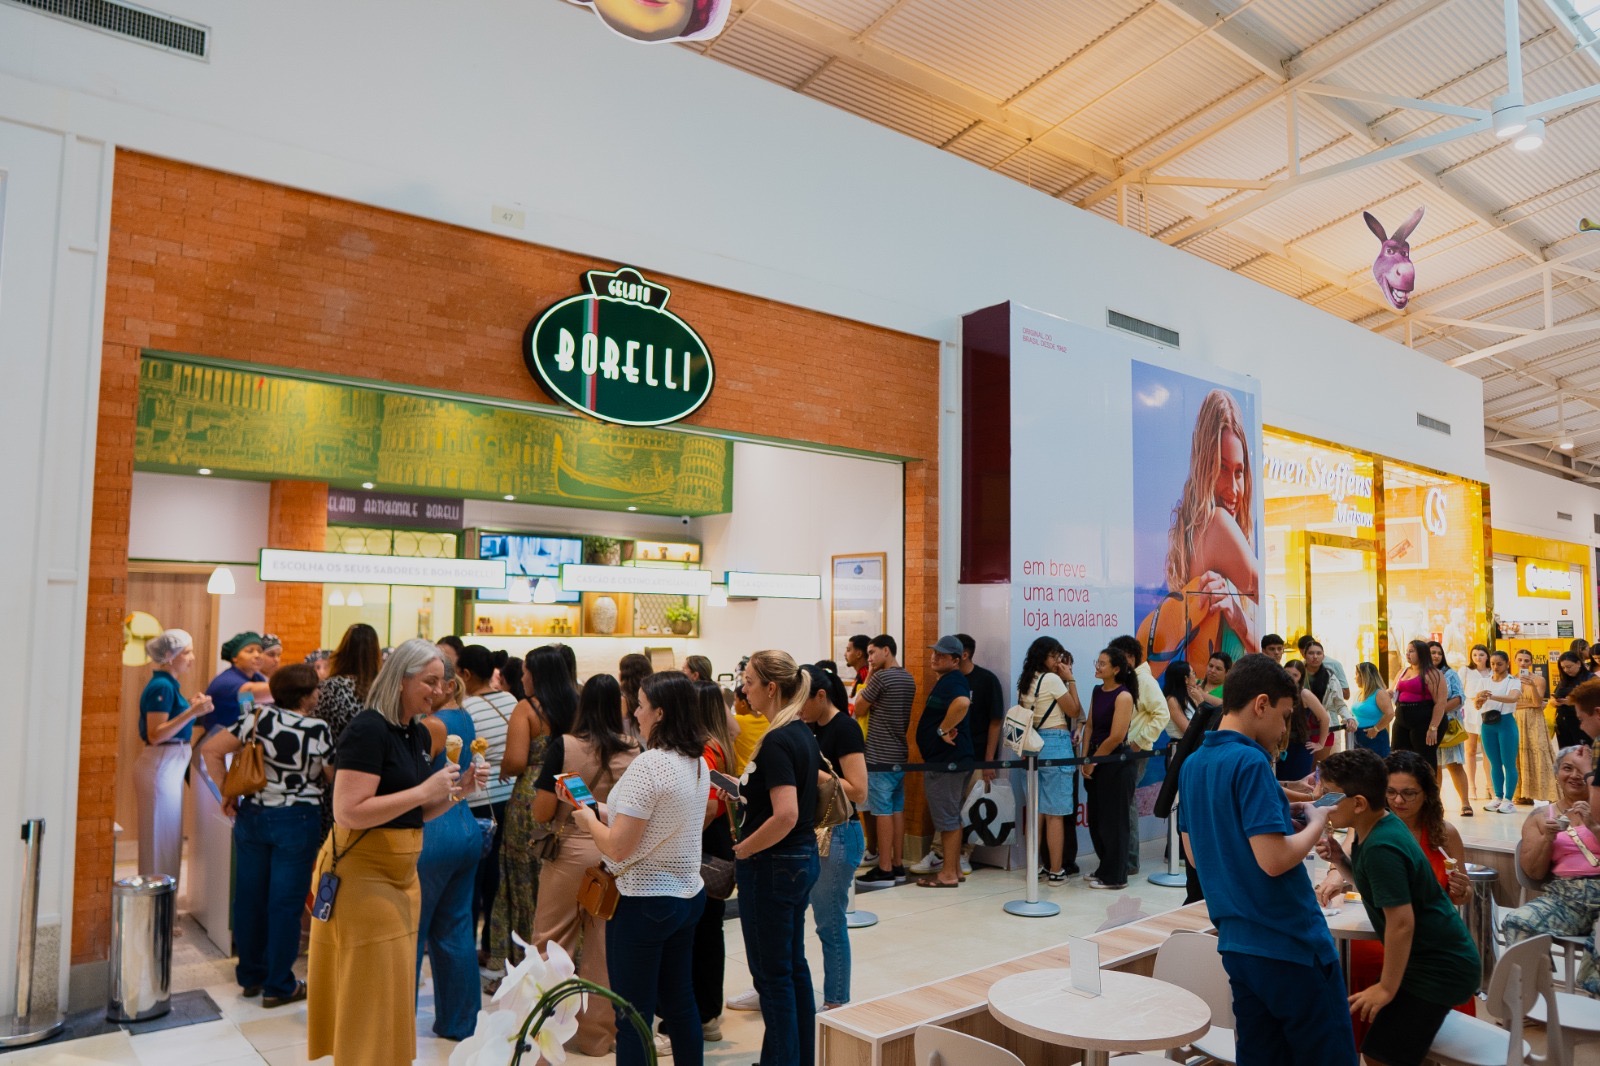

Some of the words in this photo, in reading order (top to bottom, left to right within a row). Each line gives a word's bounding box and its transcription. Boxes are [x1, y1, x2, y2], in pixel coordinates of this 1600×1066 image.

[502, 212, 513, 222] 47
[607, 279, 651, 304] GELATO
[1022, 327, 1044, 340] ORIGINAL
[1022, 335, 1040, 346] BRASIL
[1041, 340, 1056, 350] DESDE
[553, 327, 691, 392] BORELLI
[1308, 455, 1374, 502] Steffens
[426, 503, 460, 521] BORELLI
[1335, 503, 1374, 528] Maison
[273, 560, 324, 572] ESCOLHA
[326, 562, 341, 573] OS
[343, 563, 371, 574] SEUS
[373, 565, 421, 576] SABORES
[431, 568, 452, 577] BOM
[1023, 560, 1045, 576] em
[1049, 558, 1086, 578] breve
[1023, 586, 1054, 602] uma
[1058, 587, 1090, 603] nova
[1023, 608, 1050, 631] loja
[1053, 608, 1118, 627] havaianas
